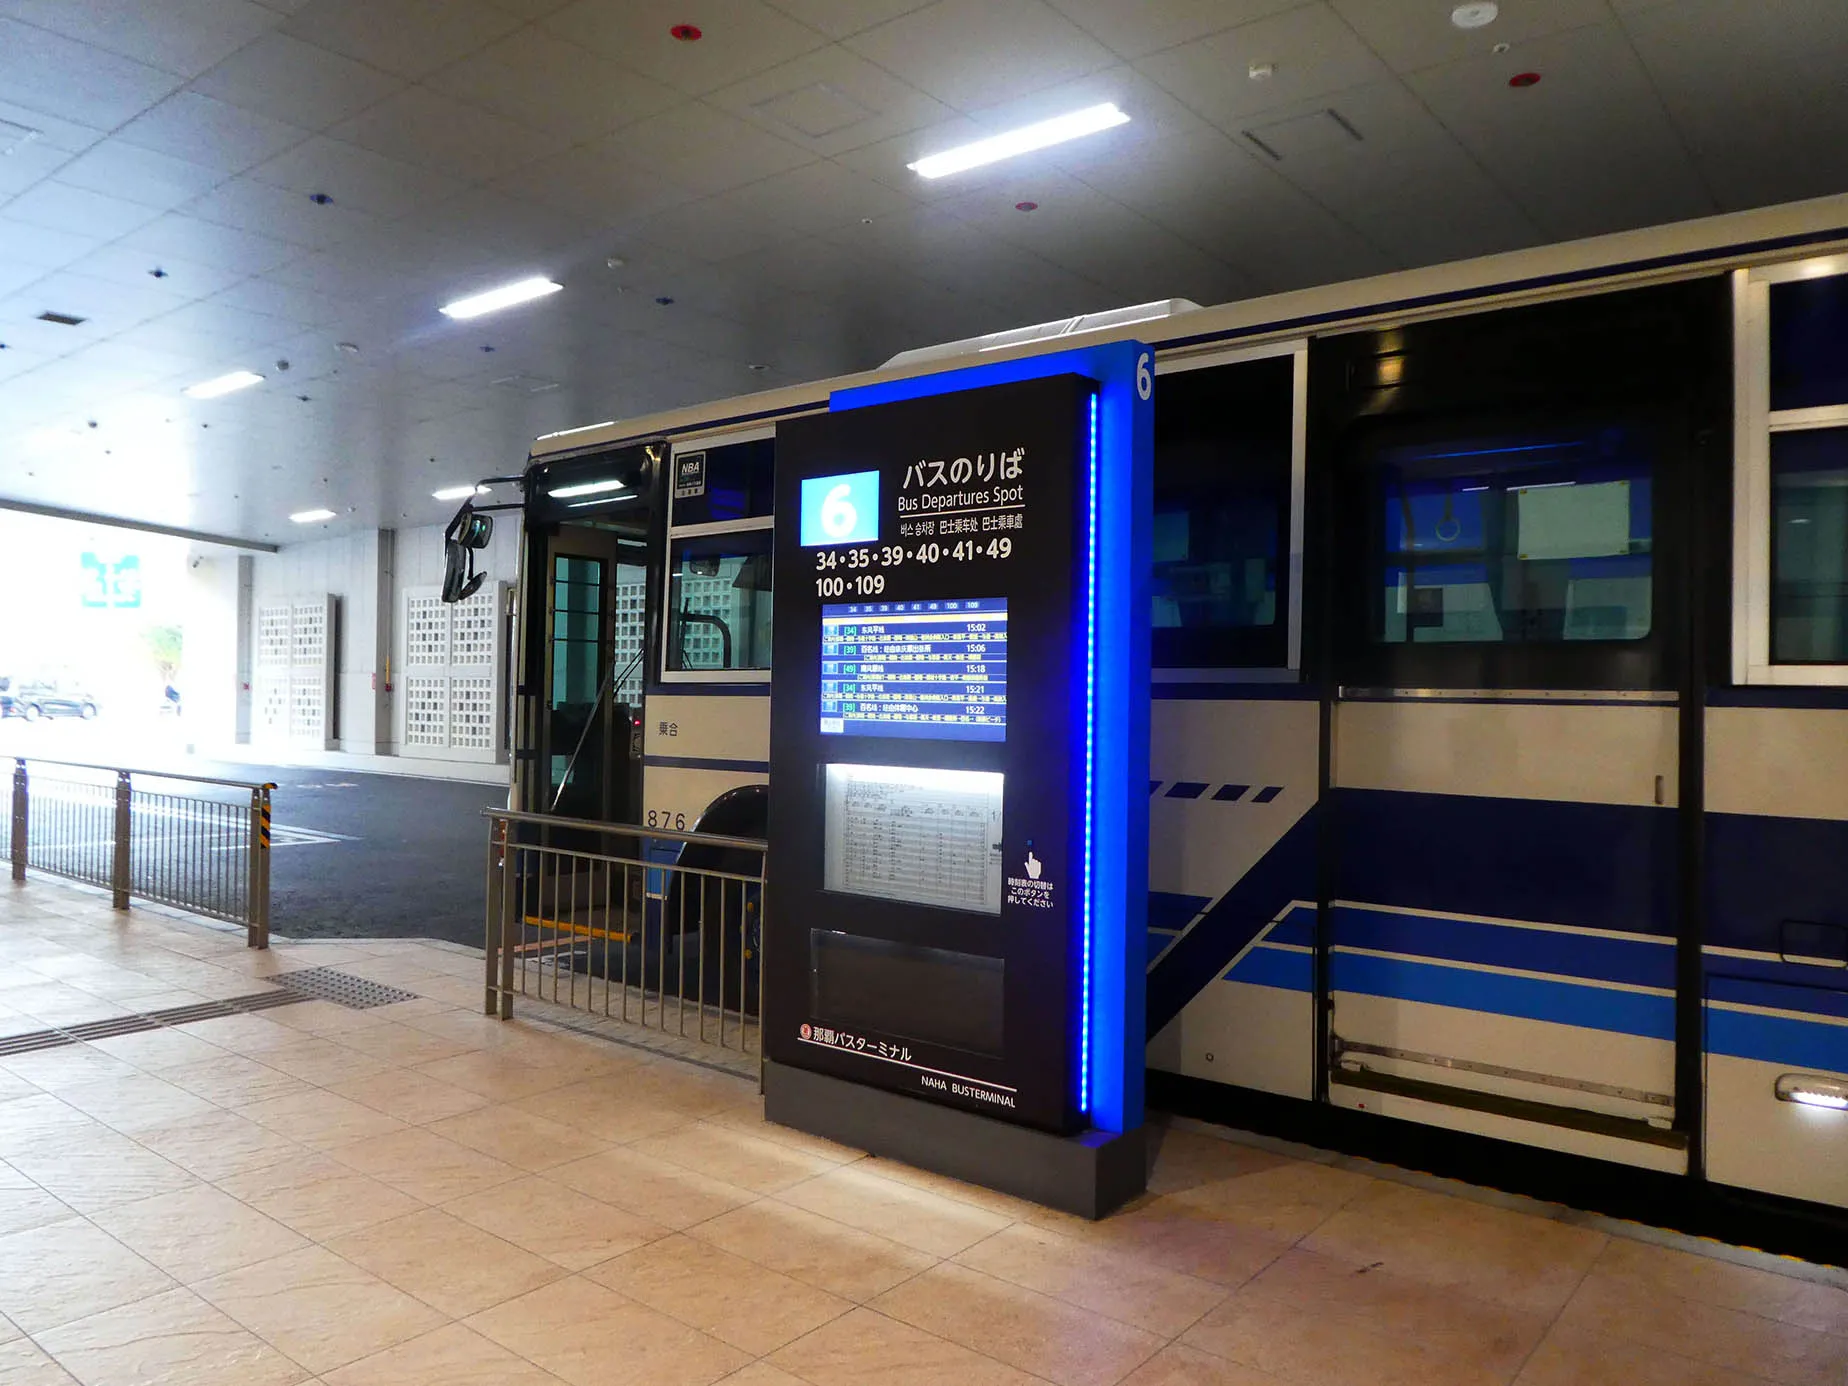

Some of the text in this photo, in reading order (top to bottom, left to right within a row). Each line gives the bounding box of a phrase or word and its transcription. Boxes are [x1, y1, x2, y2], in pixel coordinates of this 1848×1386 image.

[1136, 352, 1152, 401] 6
[902, 447, 1026, 489] バスのりば
[898, 484, 1024, 512] Bus Departures Spot
[821, 483, 857, 538] 6
[967, 623, 986, 632] 15:02
[966, 644, 986, 652] 15:06
[966, 665, 986, 673] 15:18
[966, 685, 985, 693] 15:21
[965, 706, 985, 714] 15:22
[647, 809, 686, 831] 876
[1011, 886, 1050, 899] このボタンを
[1007, 895, 1054, 908] 押してください
[813, 1026, 912, 1061] 那覇バスターミナル
[921, 1075, 1016, 1108] NAHA BUSTERMINAL
